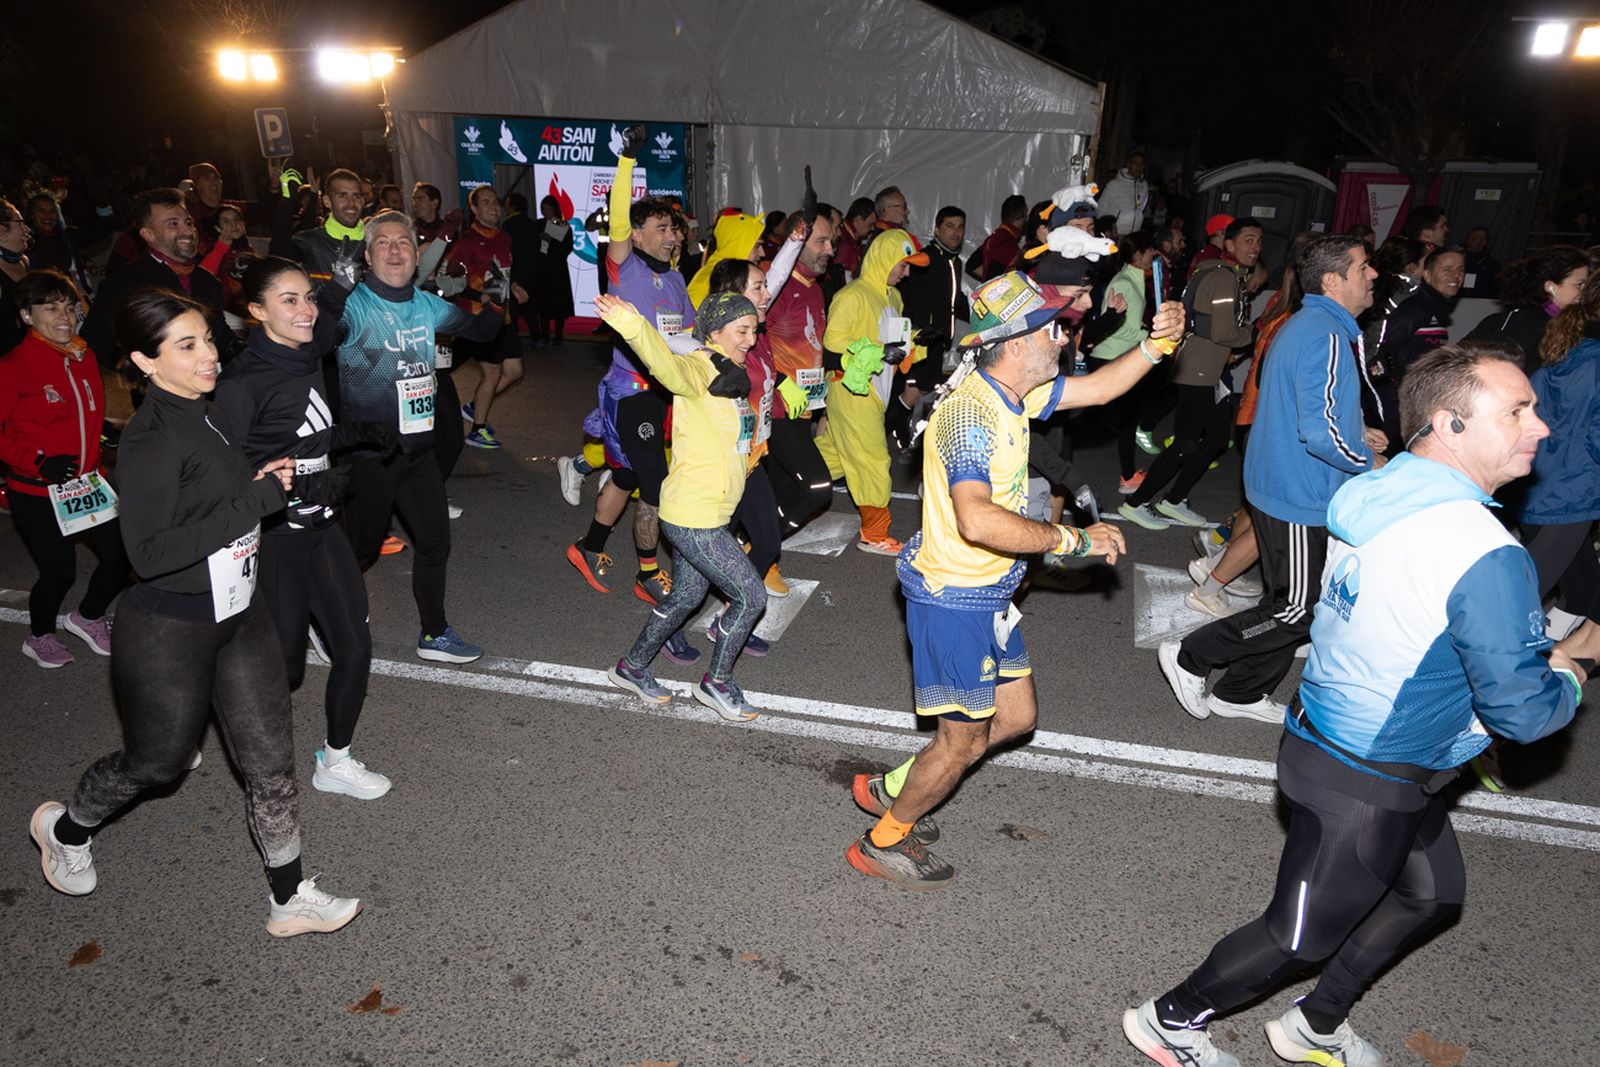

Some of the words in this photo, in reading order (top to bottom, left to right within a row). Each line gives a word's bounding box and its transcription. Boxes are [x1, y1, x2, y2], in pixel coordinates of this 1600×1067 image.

[262, 114, 283, 152] P
[541, 125, 562, 144] 43
[562, 127, 596, 144] SAN
[507, 144, 518, 156] 43
[537, 141, 594, 162] ANTÓN
[406, 391, 417, 400] SAN
[59, 492, 72, 500] SAN
[63, 488, 108, 515] 12975
[233, 547, 250, 561] SAN
